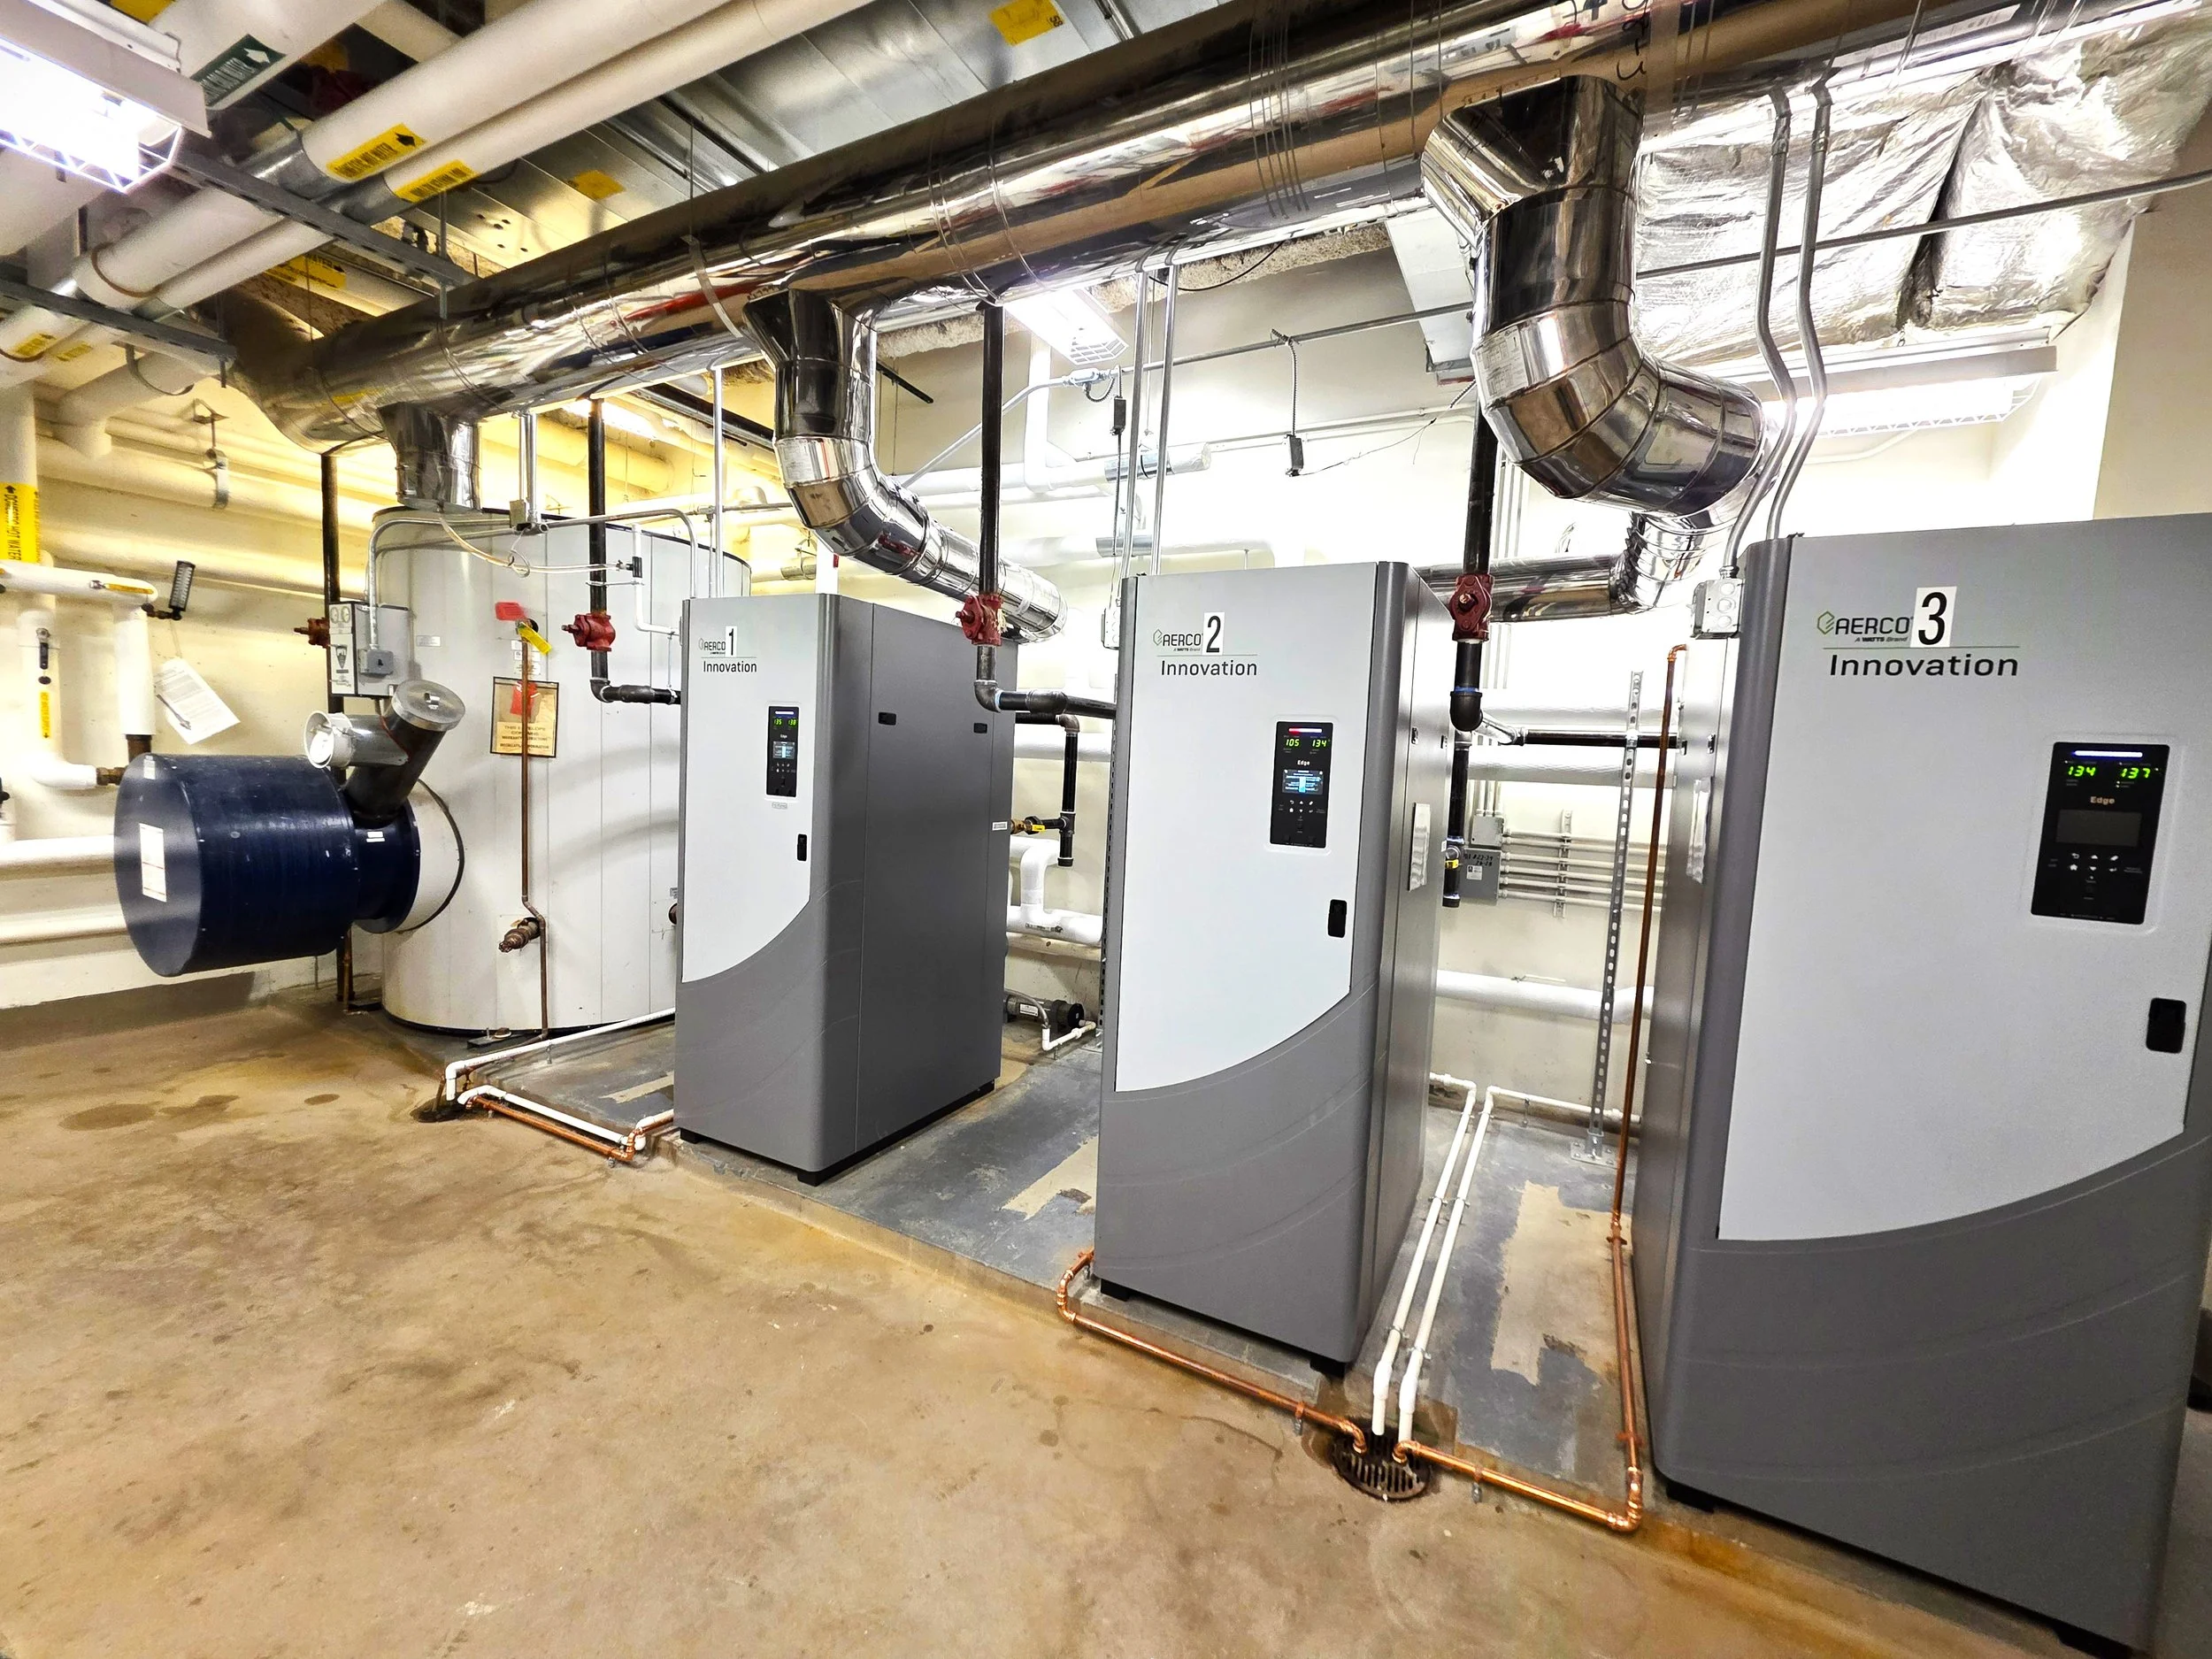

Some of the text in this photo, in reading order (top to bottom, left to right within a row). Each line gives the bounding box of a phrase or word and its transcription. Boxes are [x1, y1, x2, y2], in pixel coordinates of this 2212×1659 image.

[8, 539, 22, 561] WATER
[1834, 616, 1910, 635] AERCO
[1917, 591, 1947, 646] 3
[728, 628, 734, 656] 1
[1162, 633, 1202, 647] AERCO
[1206, 615, 1221, 653] 2
[703, 641, 726, 651] AERCO
[703, 660, 757, 672] Innovation
[1161, 659, 1257, 676] Innovation
[1830, 653, 2018, 676] Innovation
[1286, 738, 1327, 748] 105 134
[2067, 765, 2151, 779] 134 137
[2090, 795, 2116, 805] Edge
